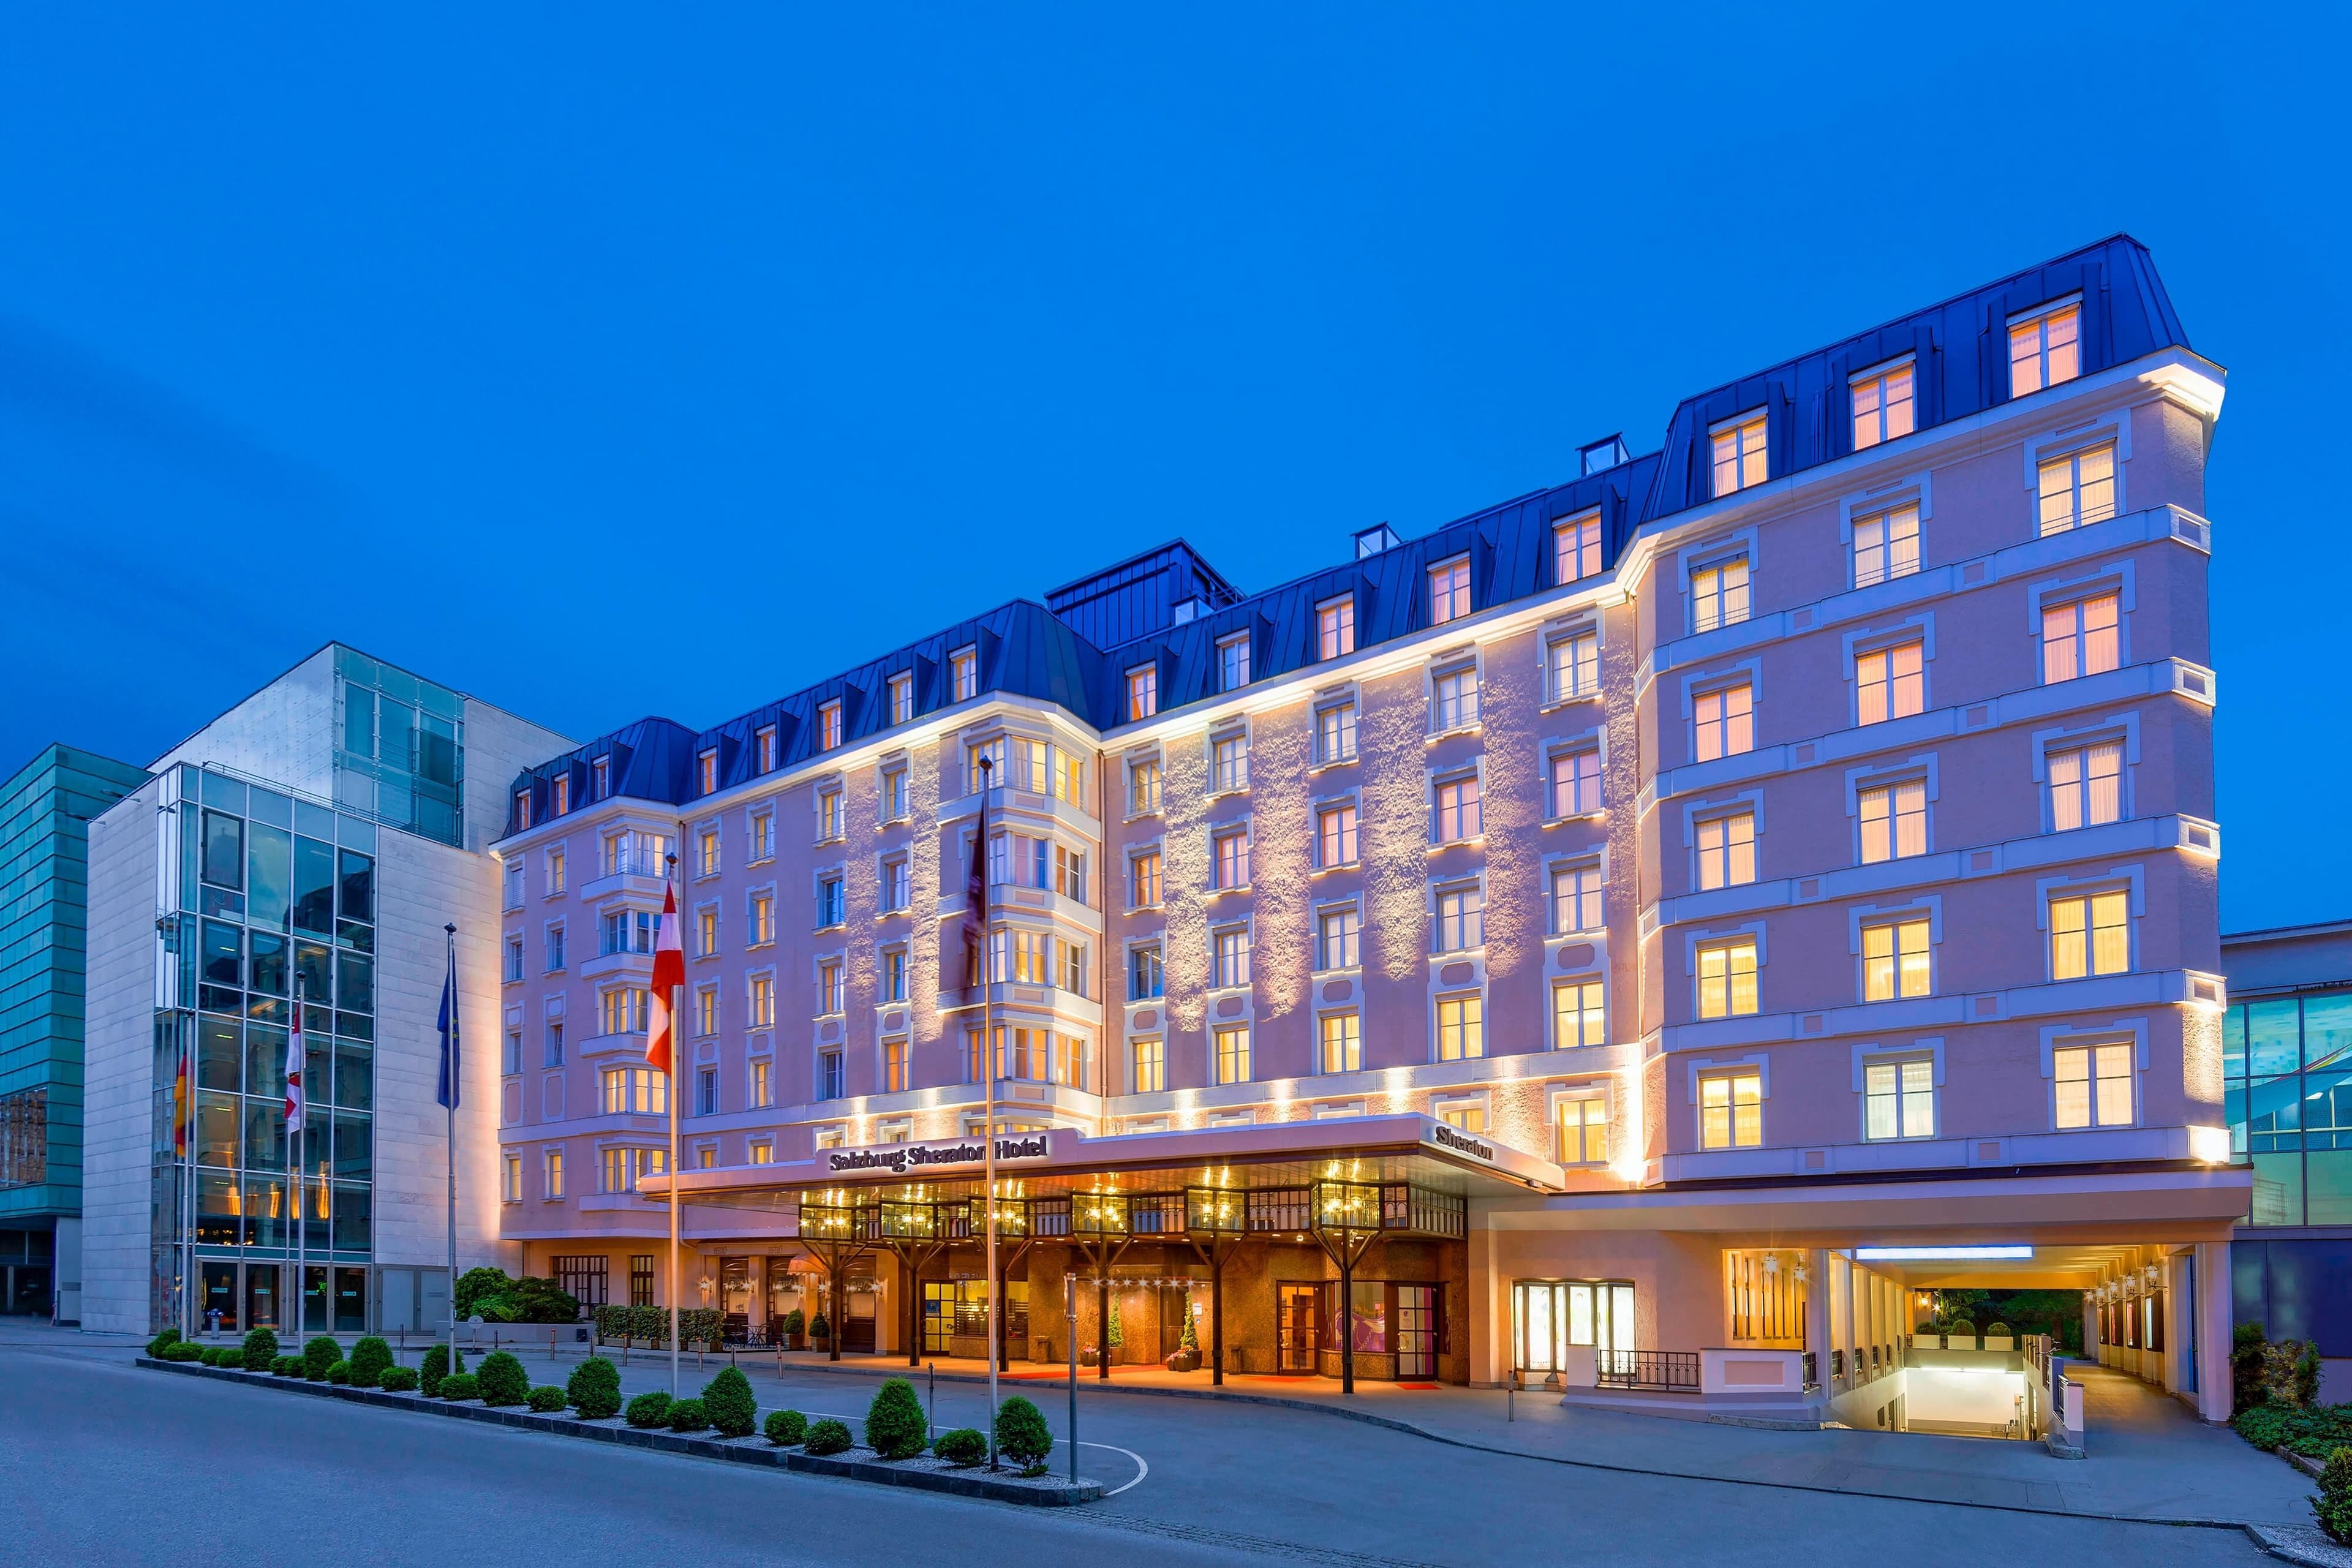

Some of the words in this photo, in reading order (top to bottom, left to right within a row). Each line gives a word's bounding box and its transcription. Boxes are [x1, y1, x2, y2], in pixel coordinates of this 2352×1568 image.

[829, 1150, 907, 1172] Salzburg
[908, 1143, 986, 1165] Sheraton
[994, 1136, 1047, 1159] Hotel
[1436, 1126, 1493, 1161] Sheraton
